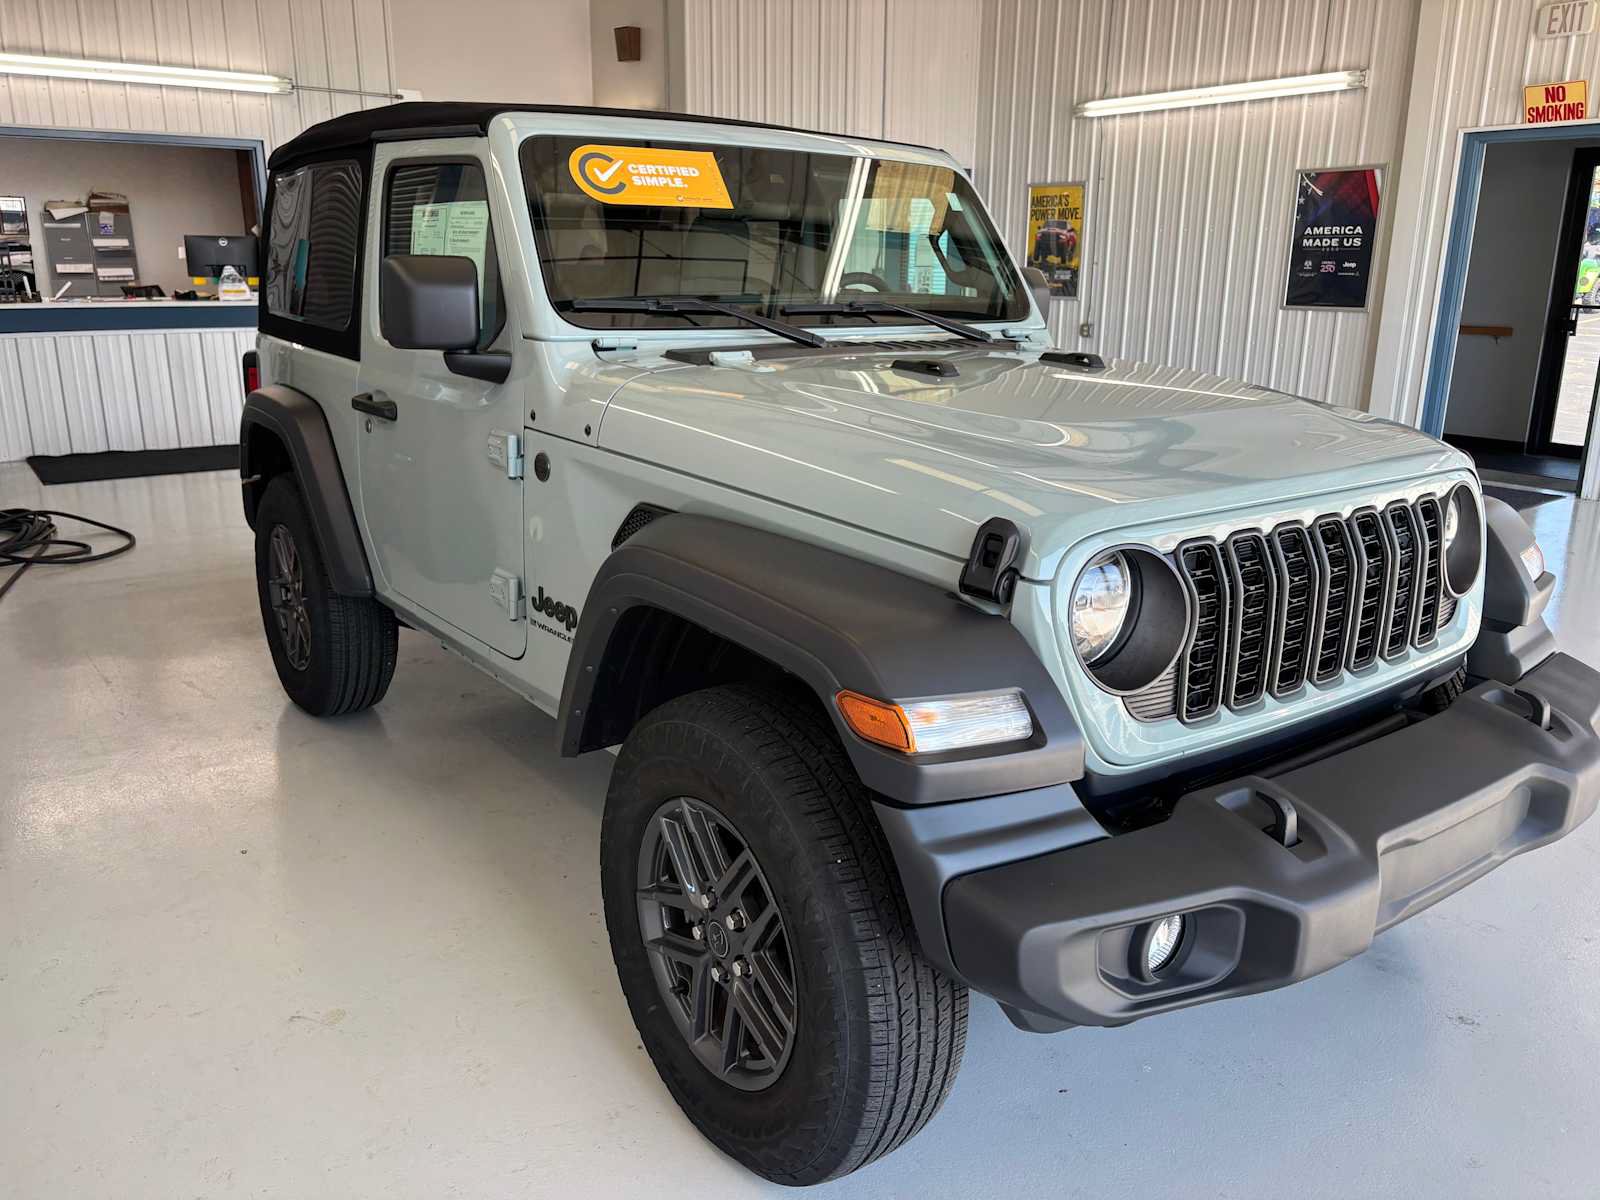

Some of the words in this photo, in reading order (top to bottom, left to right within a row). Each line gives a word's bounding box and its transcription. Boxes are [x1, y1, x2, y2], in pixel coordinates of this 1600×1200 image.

[1547, 2, 1588, 34] EXIT
[1545, 86, 1566, 103] NO
[1527, 102, 1584, 124] SMOKING
[627, 163, 700, 177] CERTIFIED
[631, 175, 689, 188] SIMPLE.
[1031, 194, 1070, 208] AMERICA'S
[1031, 207, 1056, 221] POWER
[1304, 226, 1363, 235] AMERICA
[1302, 237, 1340, 247] MADE
[1343, 237, 1362, 247] US
[1320, 264, 1336, 273] 250
[1342, 261, 1357, 269] Jeep
[531, 585, 577, 632] Jeep
[536, 620, 573, 643] WRANGLE
